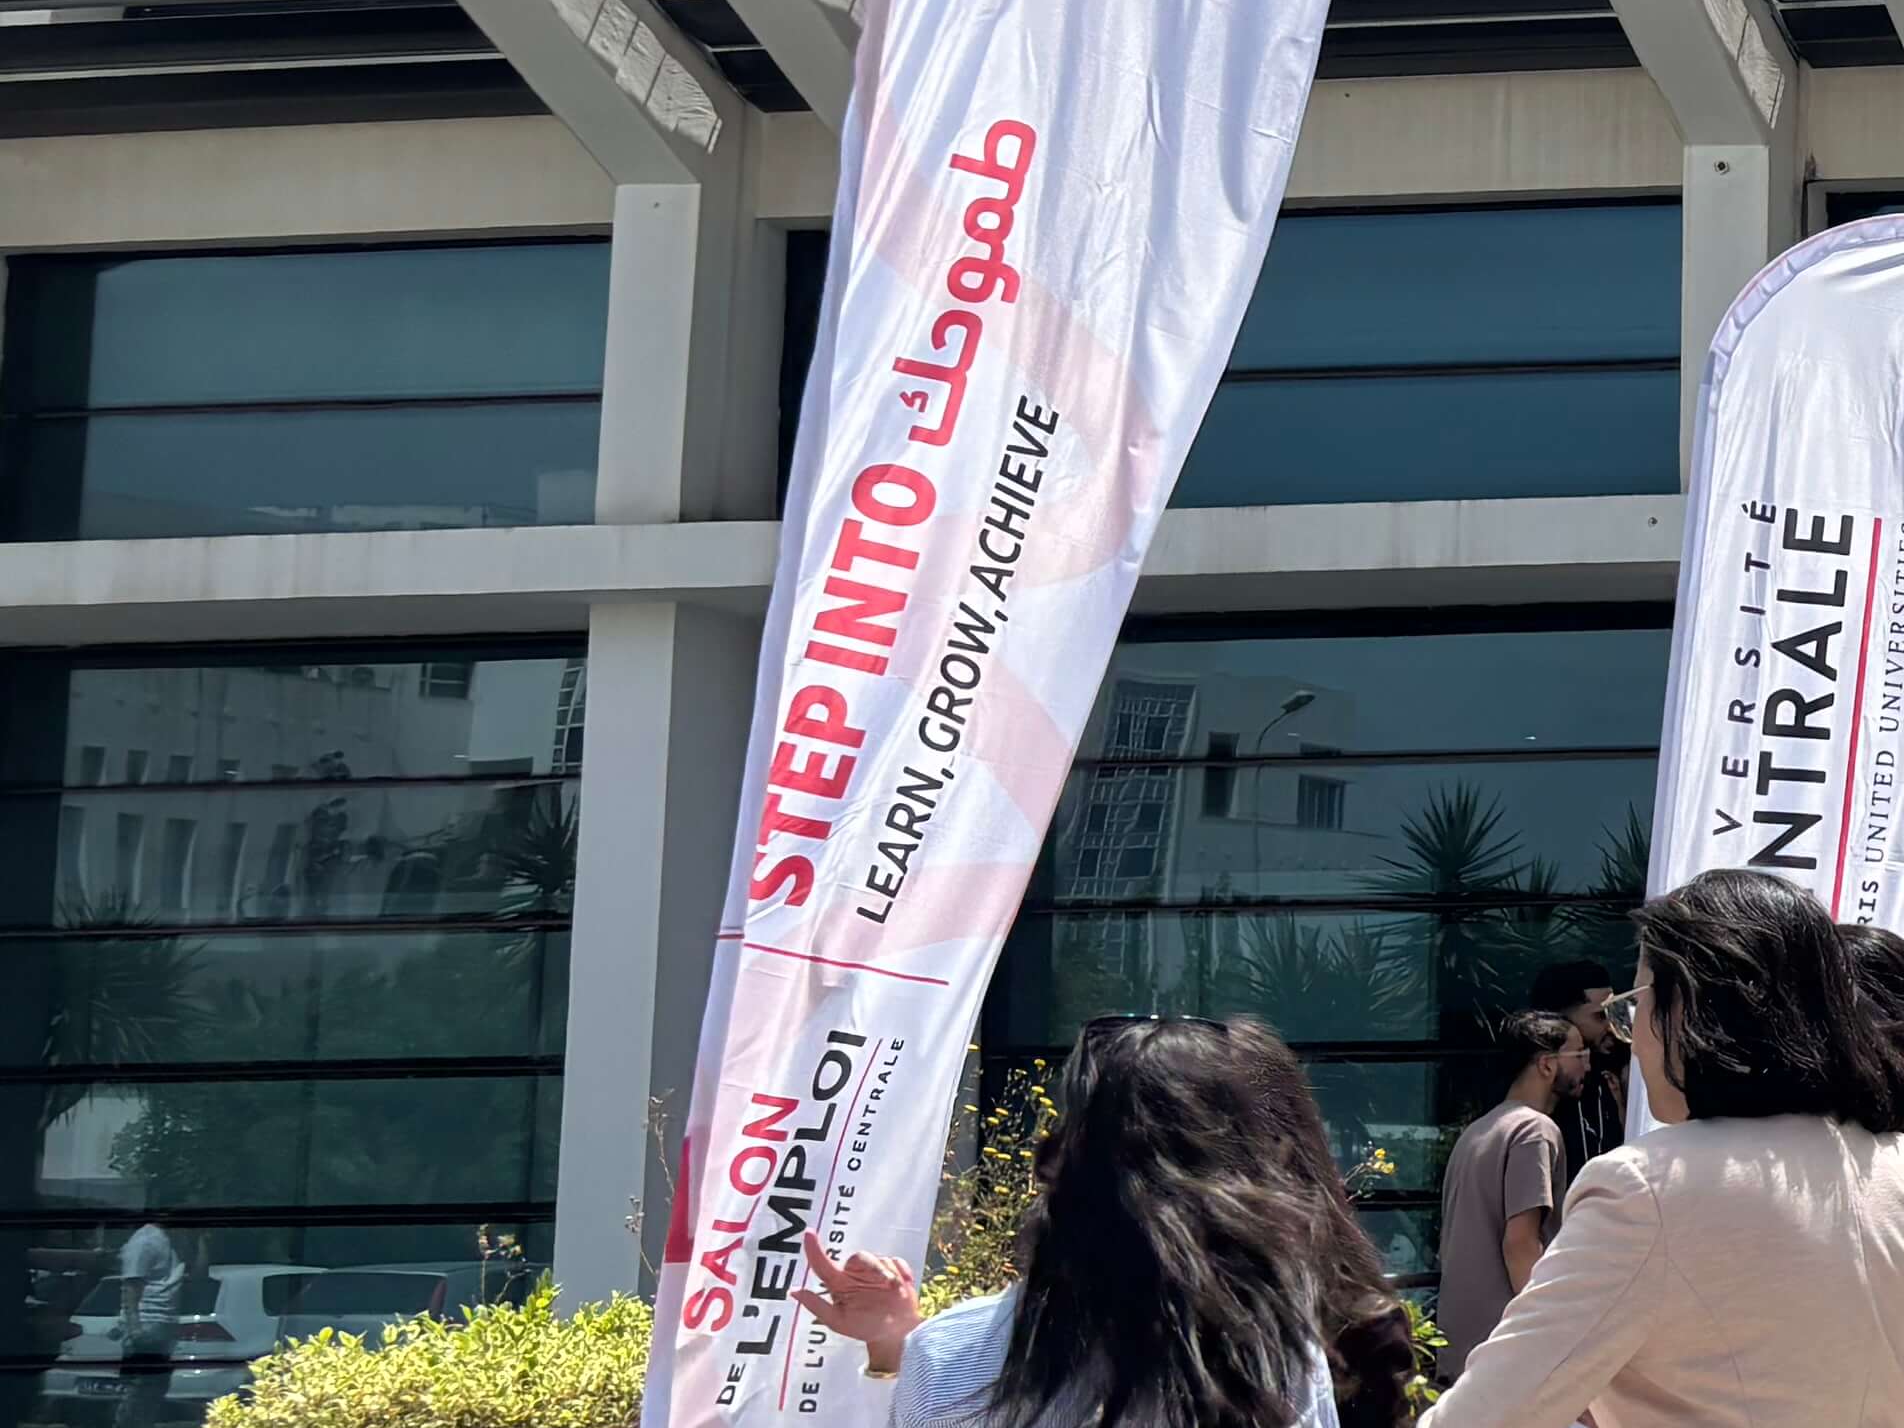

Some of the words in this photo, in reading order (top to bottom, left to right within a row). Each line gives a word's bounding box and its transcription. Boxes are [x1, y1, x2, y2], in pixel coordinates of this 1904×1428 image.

[894, 119, 1037, 447] طموحك
[805, 464, 937, 676] INTO
[856, 766, 955, 924] LEARN,
[918, 601, 1009, 754] GROW,
[970, 395, 1059, 602] ACHIEVE
[1713, 500, 1777, 836] VERSITÉ
[1747, 507, 1854, 872] NTRALE
[749, 685, 865, 908] STEP
[1857, 880, 1880, 926] RIS
[1864, 750, 1894, 863] UNITED
[682, 1093, 800, 1332] SALON
[716, 1362, 746, 1406] DE
[735, 1030, 867, 1356] L'EMPLOI
[799, 1382, 820, 1413] DE
[847, 1038, 905, 1171] CENTRALE
